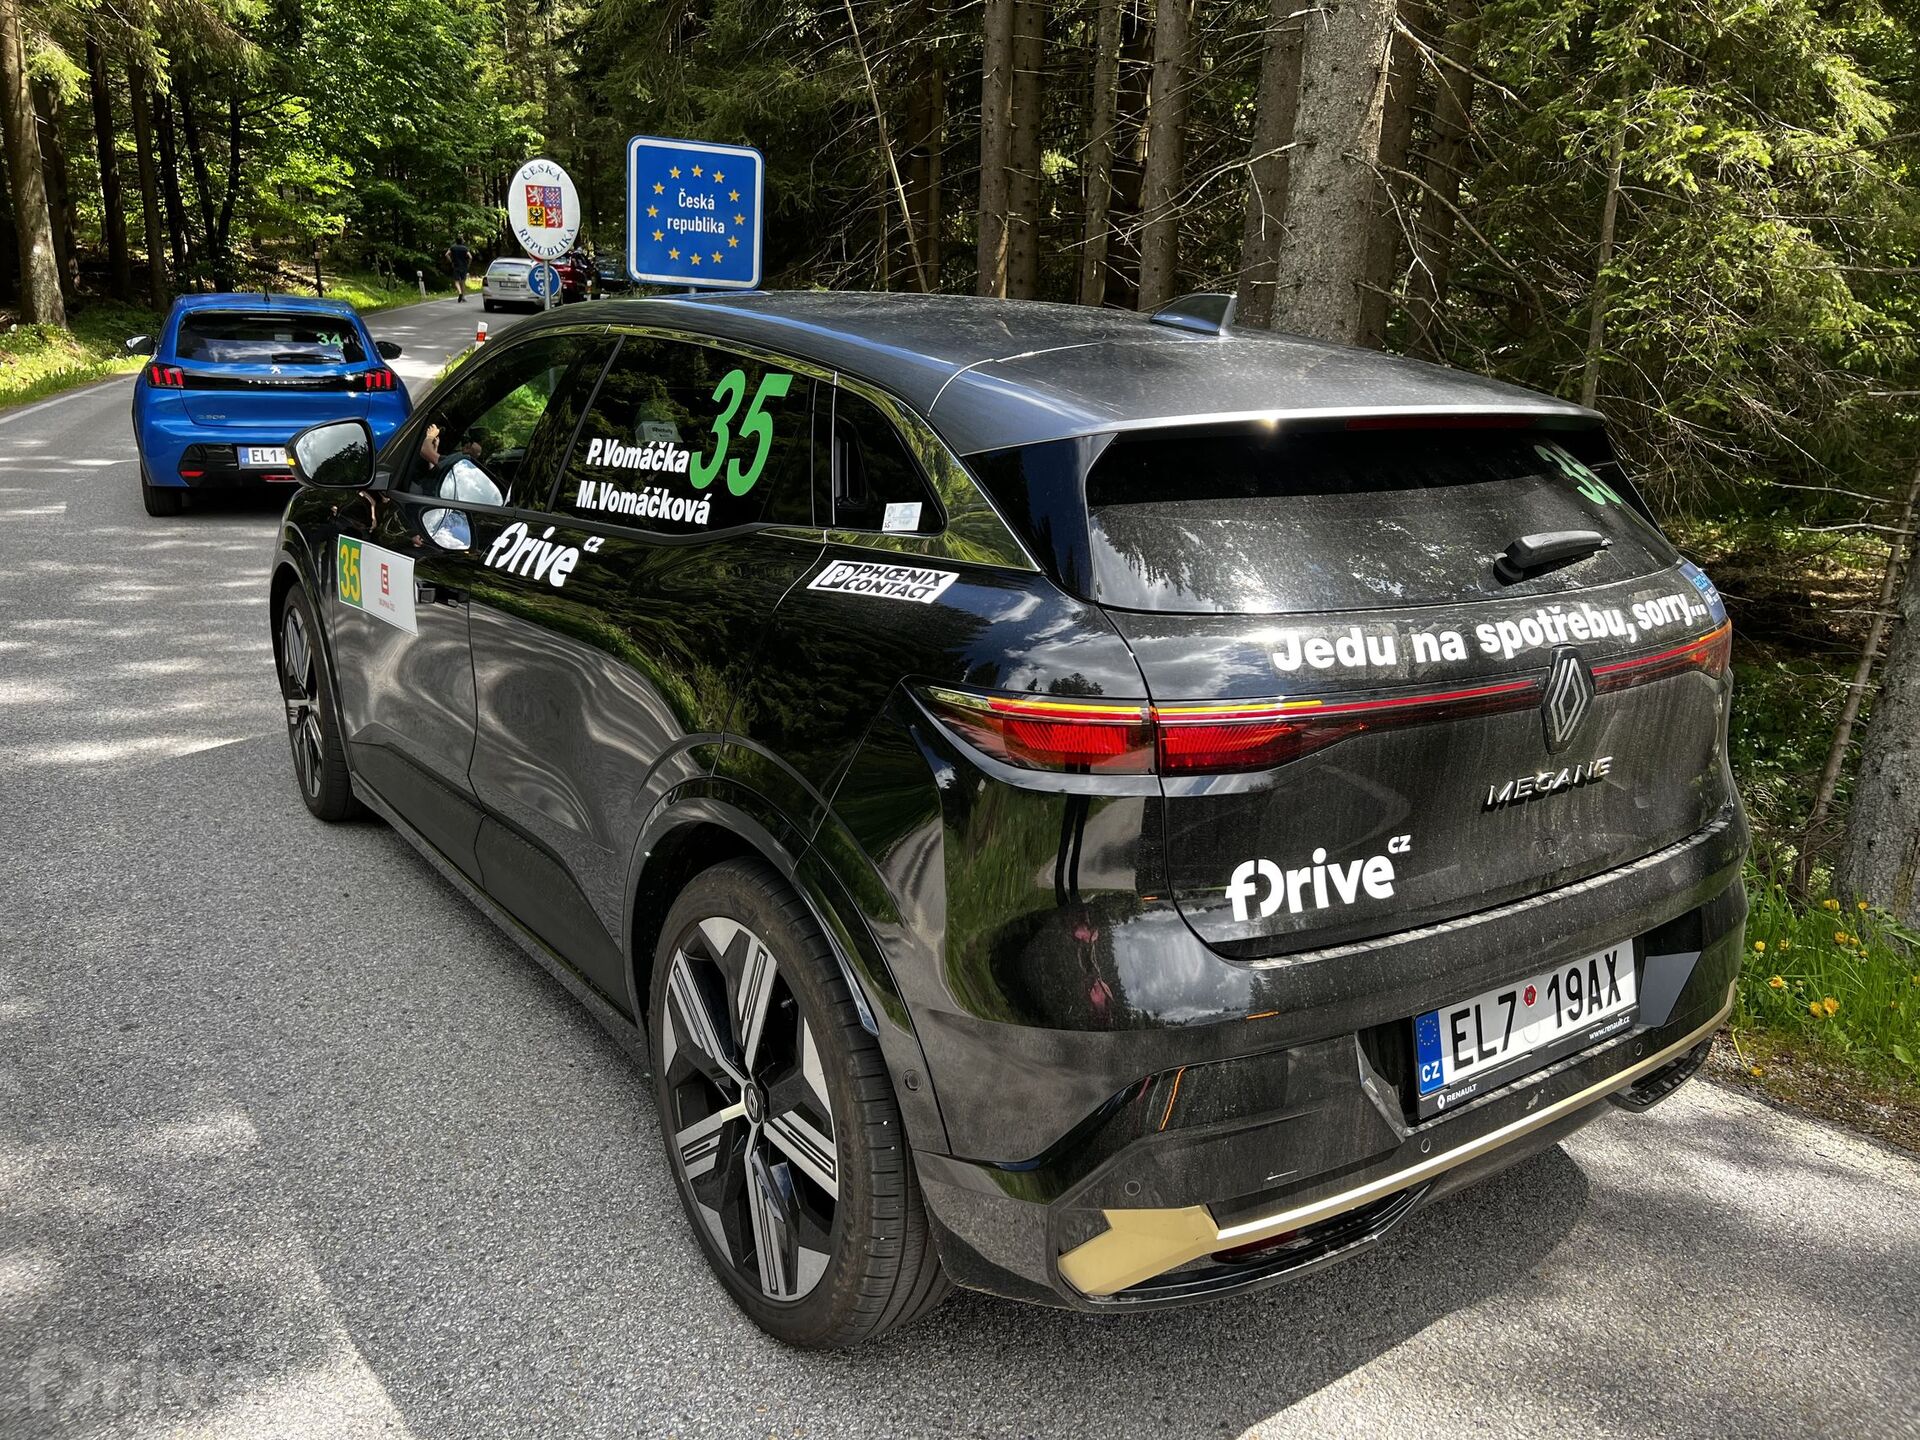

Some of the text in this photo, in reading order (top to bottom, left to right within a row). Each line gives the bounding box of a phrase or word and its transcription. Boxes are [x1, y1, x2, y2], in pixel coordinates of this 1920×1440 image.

[521, 163, 562, 182] ČESKÁ
[678, 188, 715, 211] Česká
[667, 216, 725, 237] republika
[518, 227, 576, 257] REPUBLIKA
[316, 332, 344, 348] 34
[689, 369, 793, 497] 35
[251, 449, 278, 462] EL1
[586, 438, 690, 473] P.Vomáčka
[576, 480, 712, 525] M.Vomáčková
[341, 544, 360, 602] 35
[842, 578, 936, 600] CONTACT
[1273, 621, 1396, 672] Jedu
[1414, 629, 1466, 664] na
[1486, 757, 1613, 808] MEGANE
[1450, 950, 1621, 1071] EL7 19AX
[1589, 1015, 1630, 1040] www.renault.cz
[1422, 1061, 1441, 1082] CZ
[1447, 1084, 1477, 1102] RENAULT
